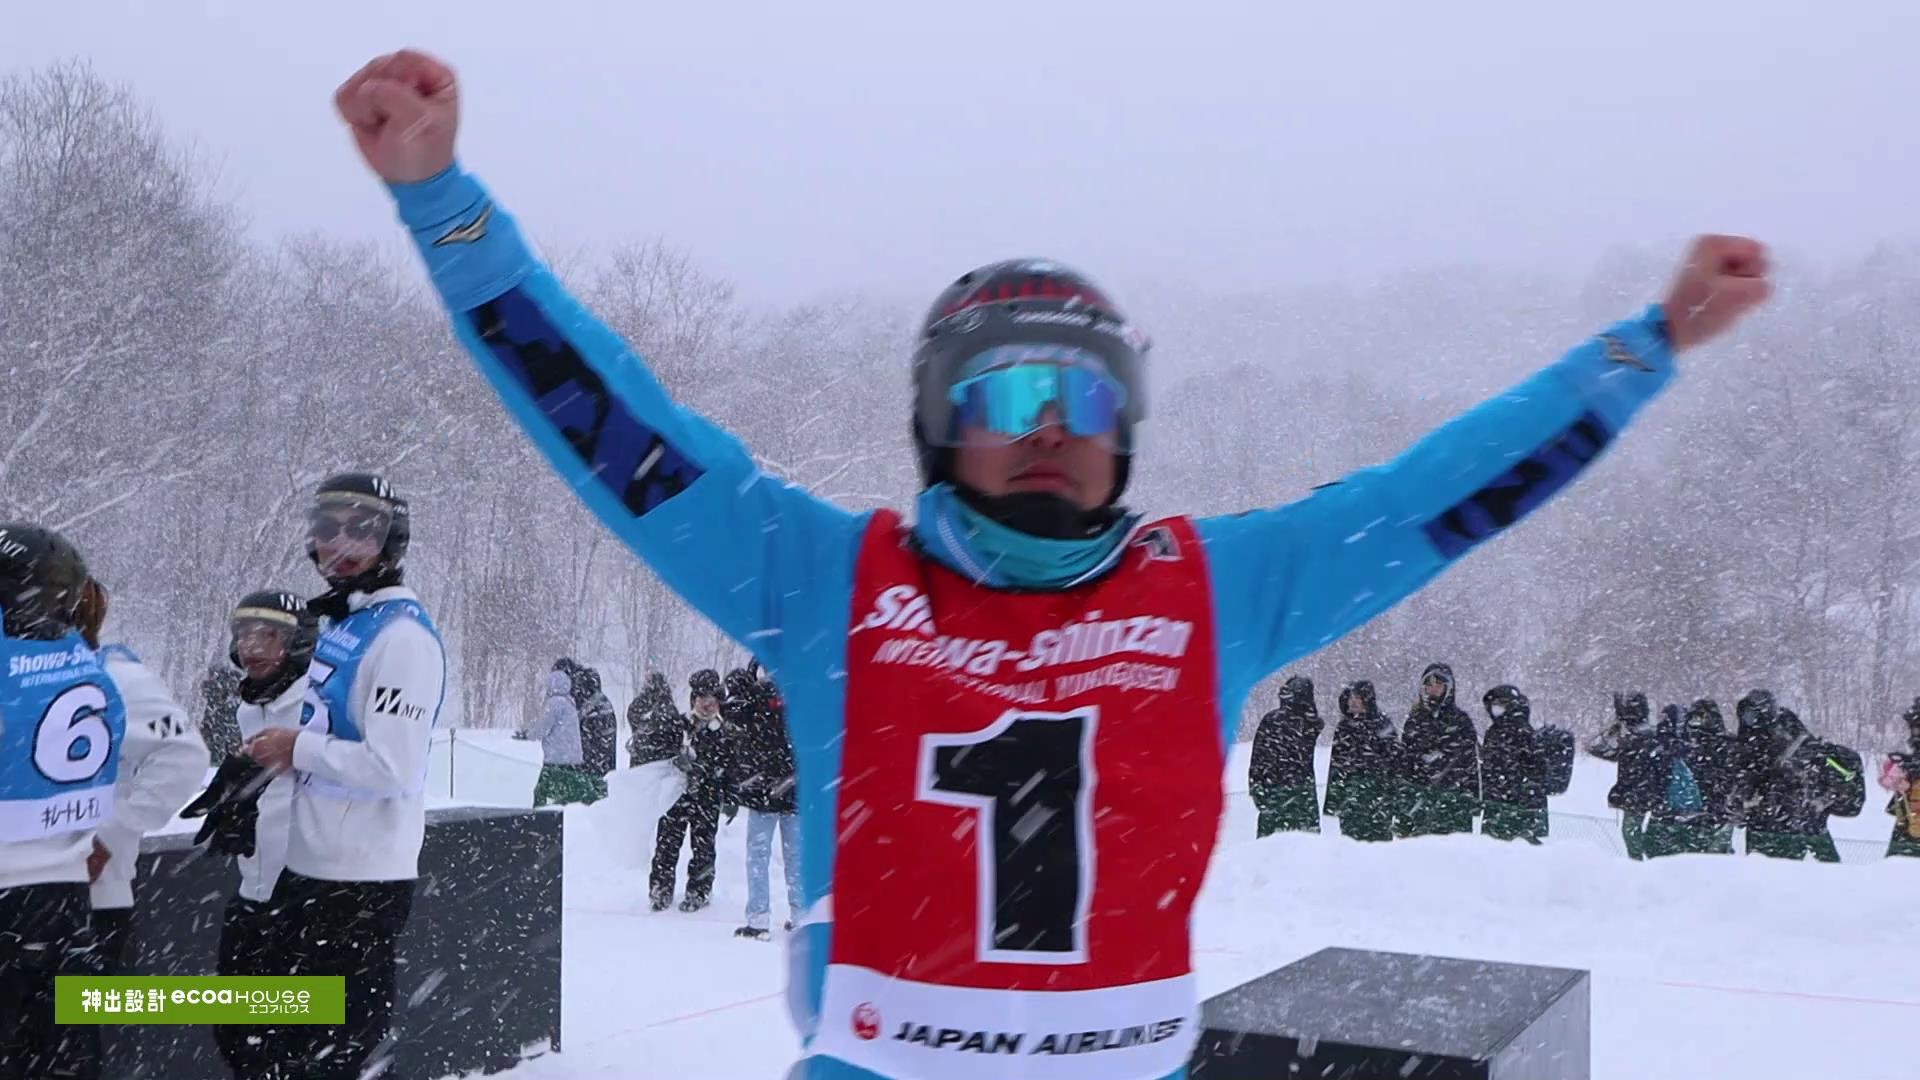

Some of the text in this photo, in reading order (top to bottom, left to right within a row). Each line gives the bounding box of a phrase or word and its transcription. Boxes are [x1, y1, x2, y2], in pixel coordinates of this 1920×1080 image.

[32, 681, 113, 784] 6
[914, 704, 1100, 966] 1
[892, 1016, 1186, 1055] JAPAN AIRLINES
